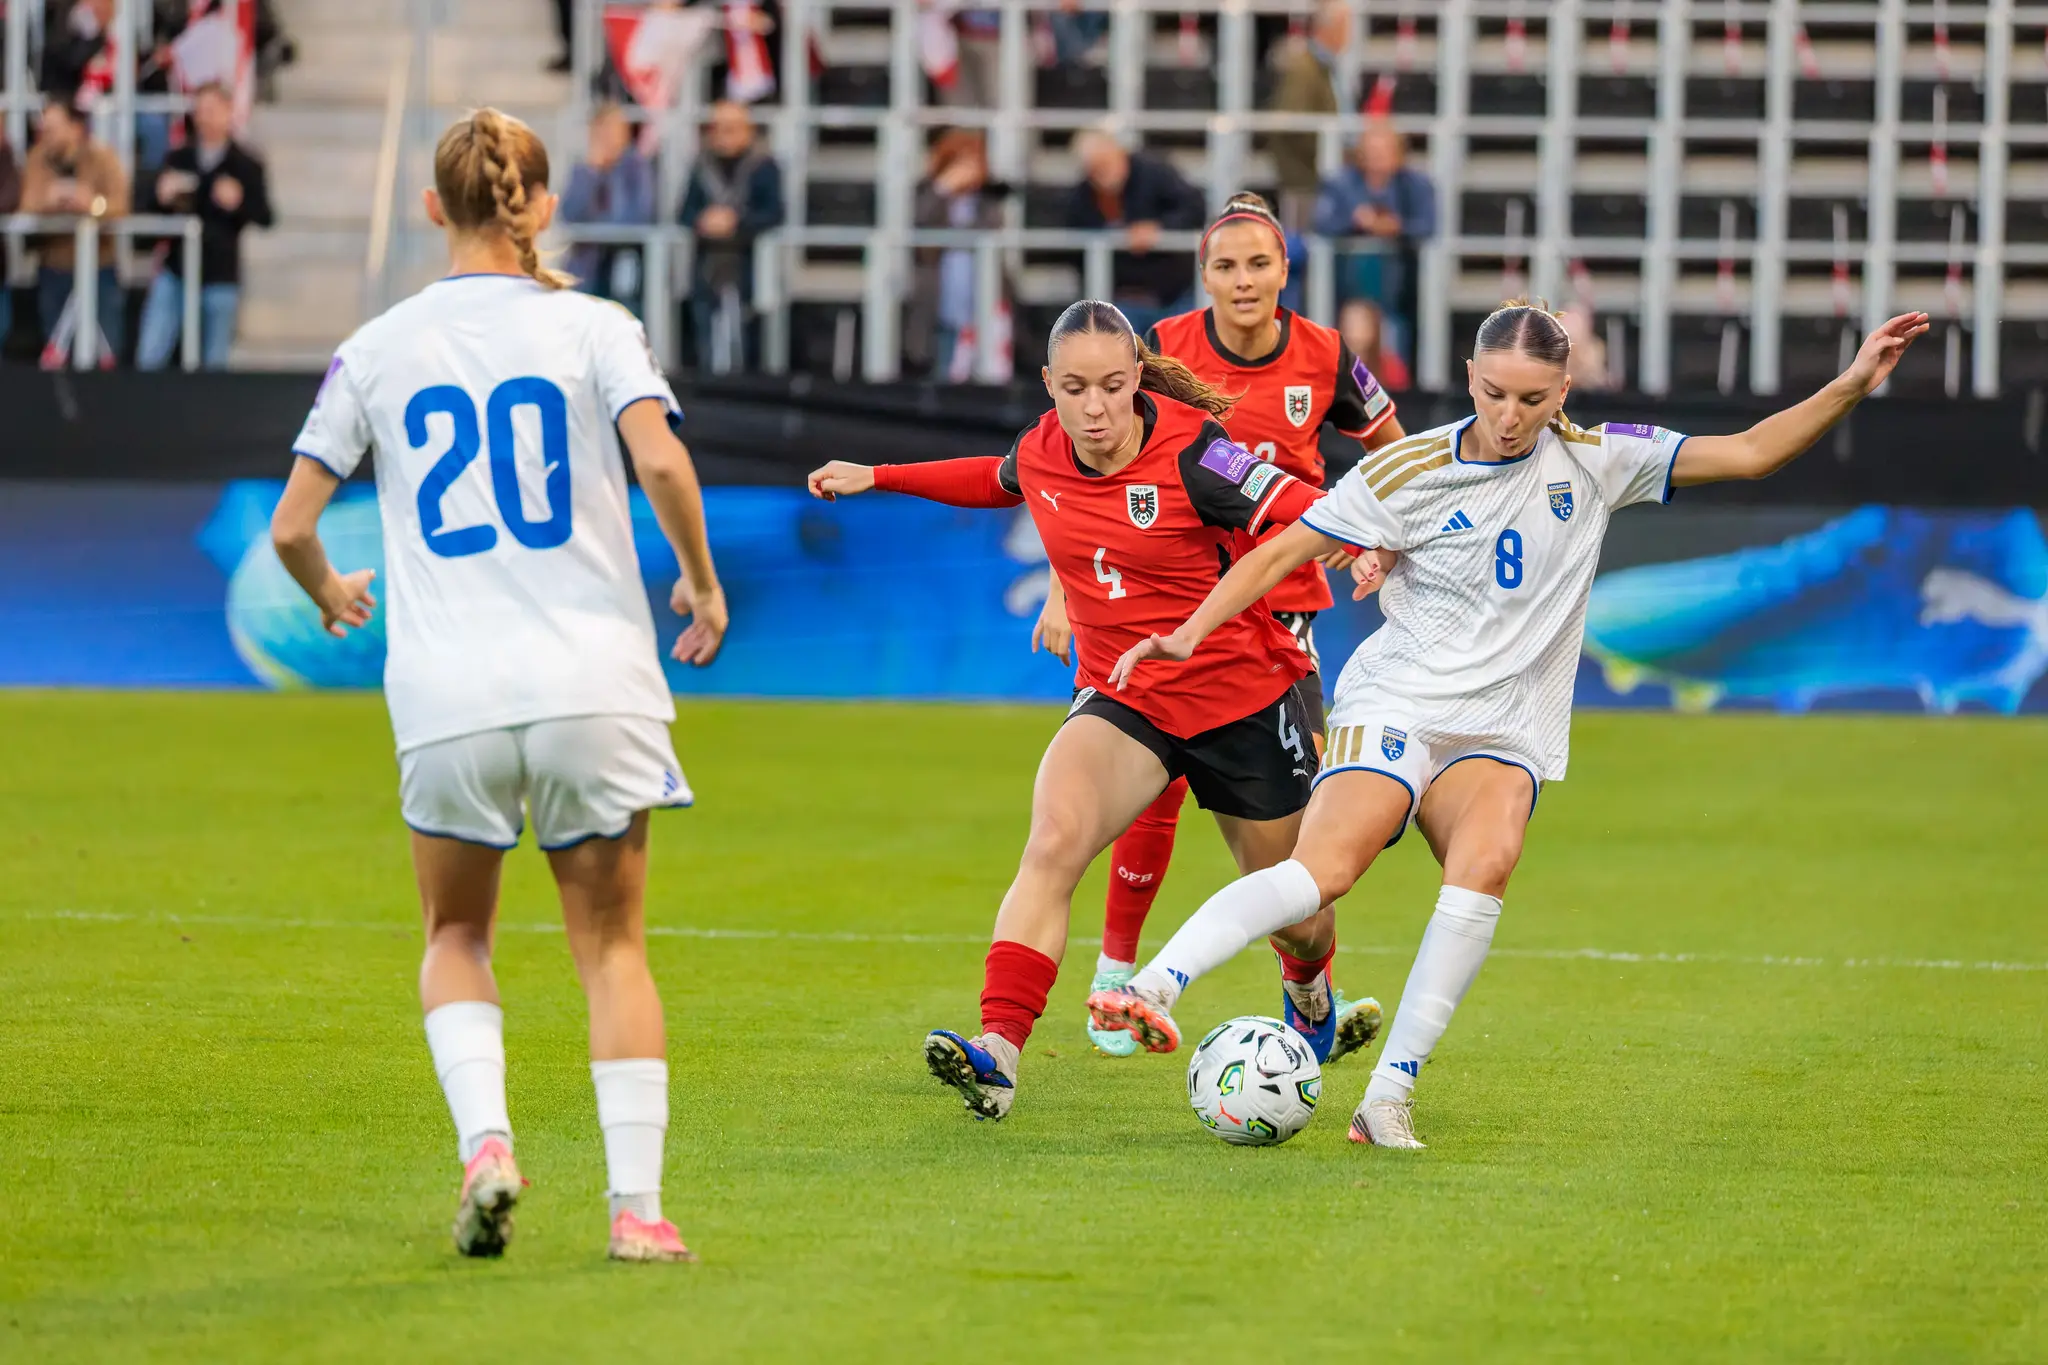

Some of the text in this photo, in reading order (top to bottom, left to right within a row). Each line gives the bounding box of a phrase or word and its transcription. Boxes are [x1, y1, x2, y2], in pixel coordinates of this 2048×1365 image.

[404, 376, 573, 559] 20
[1226, 452, 1248, 475] EUROP
[1231, 454, 1253, 478] QUALIF
[1245, 466, 1270, 496] FOUND
[1093, 547, 1127, 600] 4
[1495, 528, 1523, 589] 8
[1278, 702, 1305, 763] 4
[1277, 1038, 1295, 1064] NITRO
